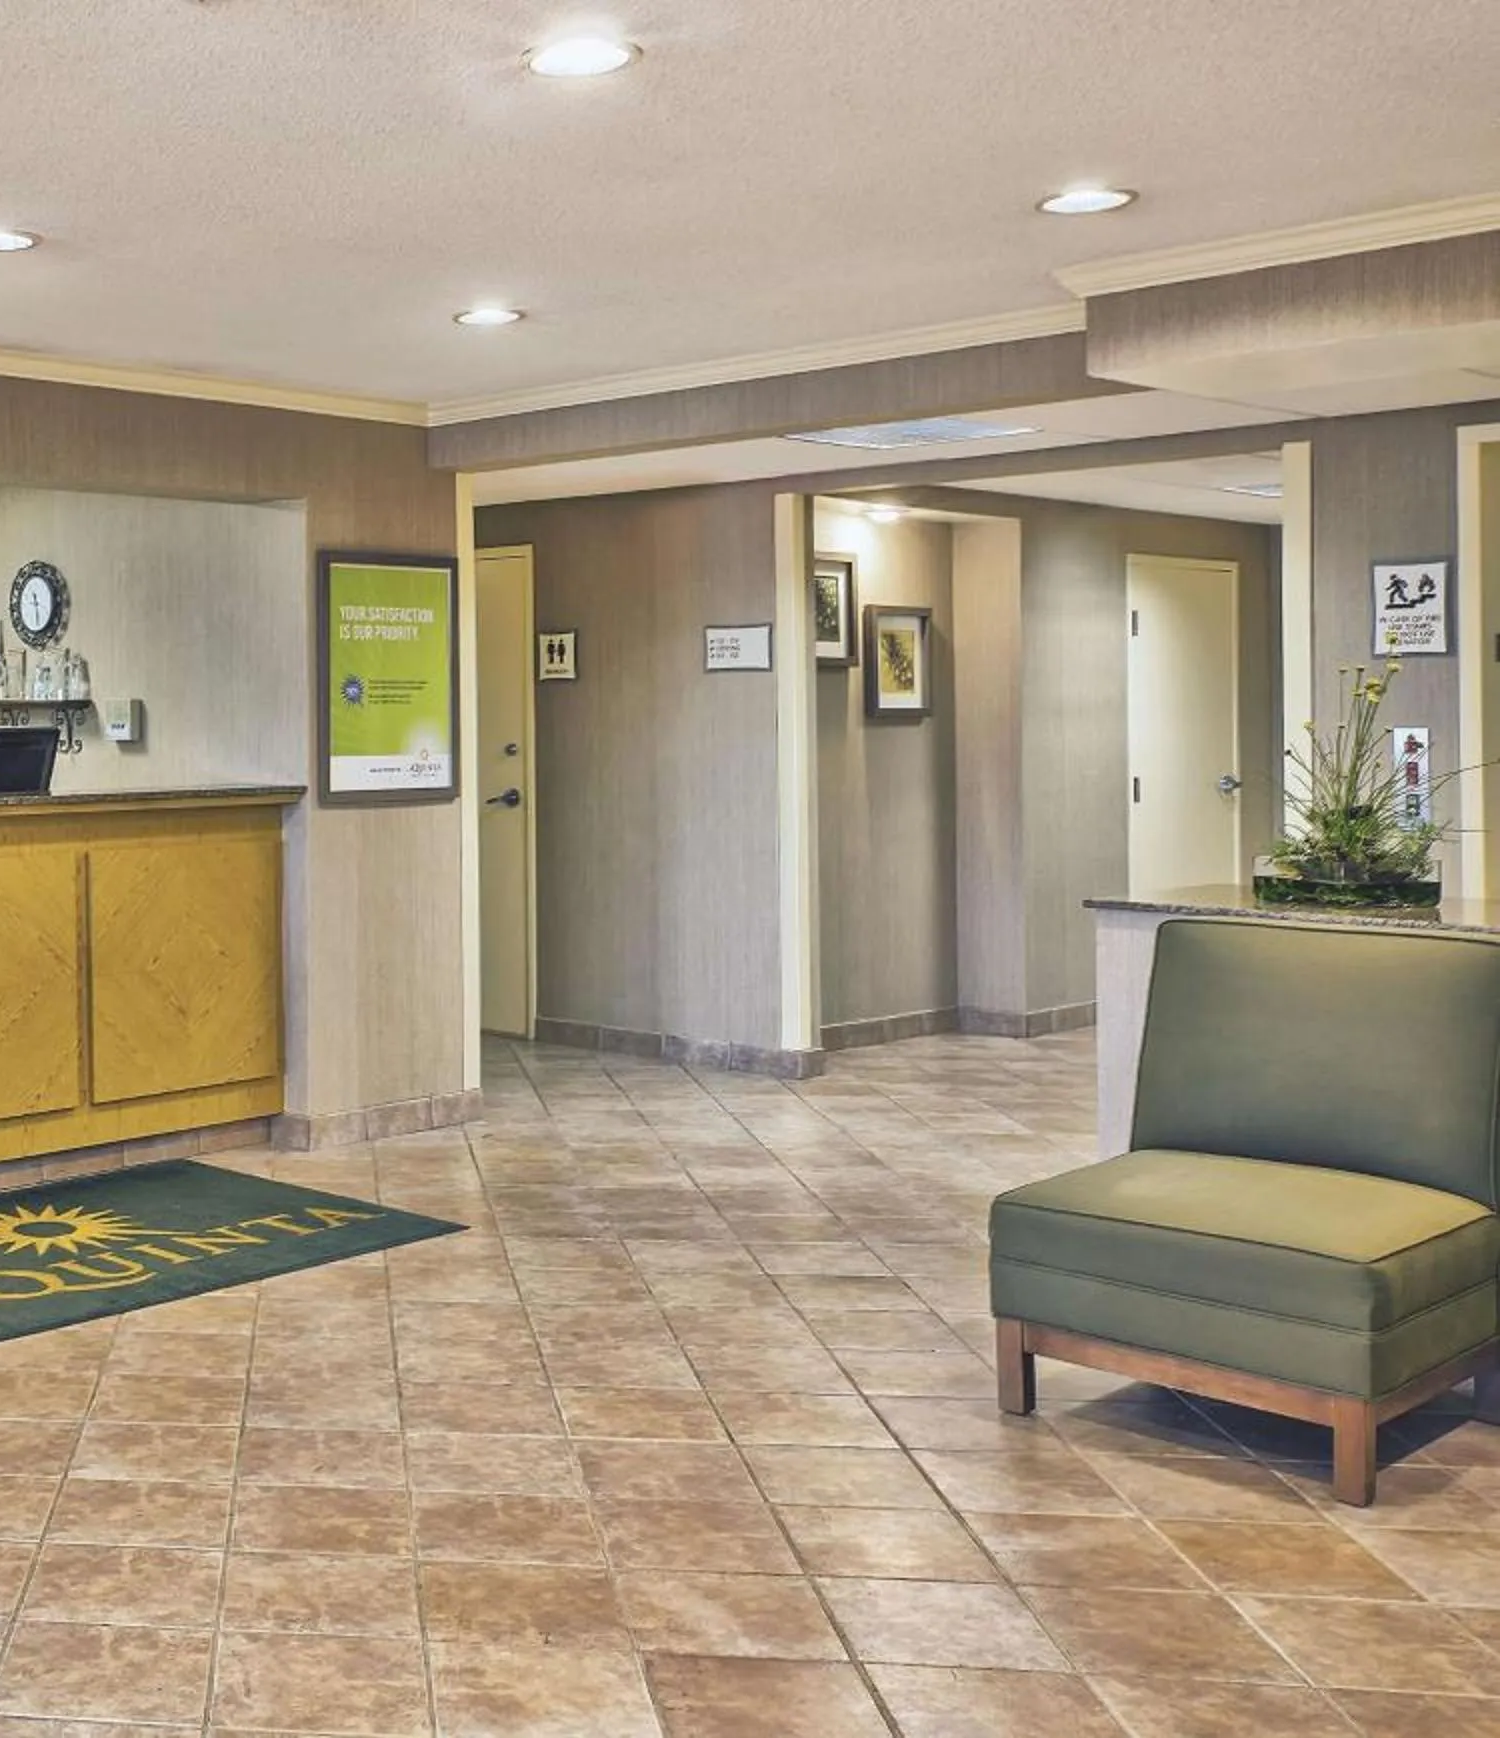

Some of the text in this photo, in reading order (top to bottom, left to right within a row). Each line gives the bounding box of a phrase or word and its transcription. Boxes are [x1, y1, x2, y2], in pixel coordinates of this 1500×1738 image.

[339, 606, 434, 624] YOUR SATISFACTION
[339, 624, 351, 640] IS
[352, 624, 373, 640] OUR
